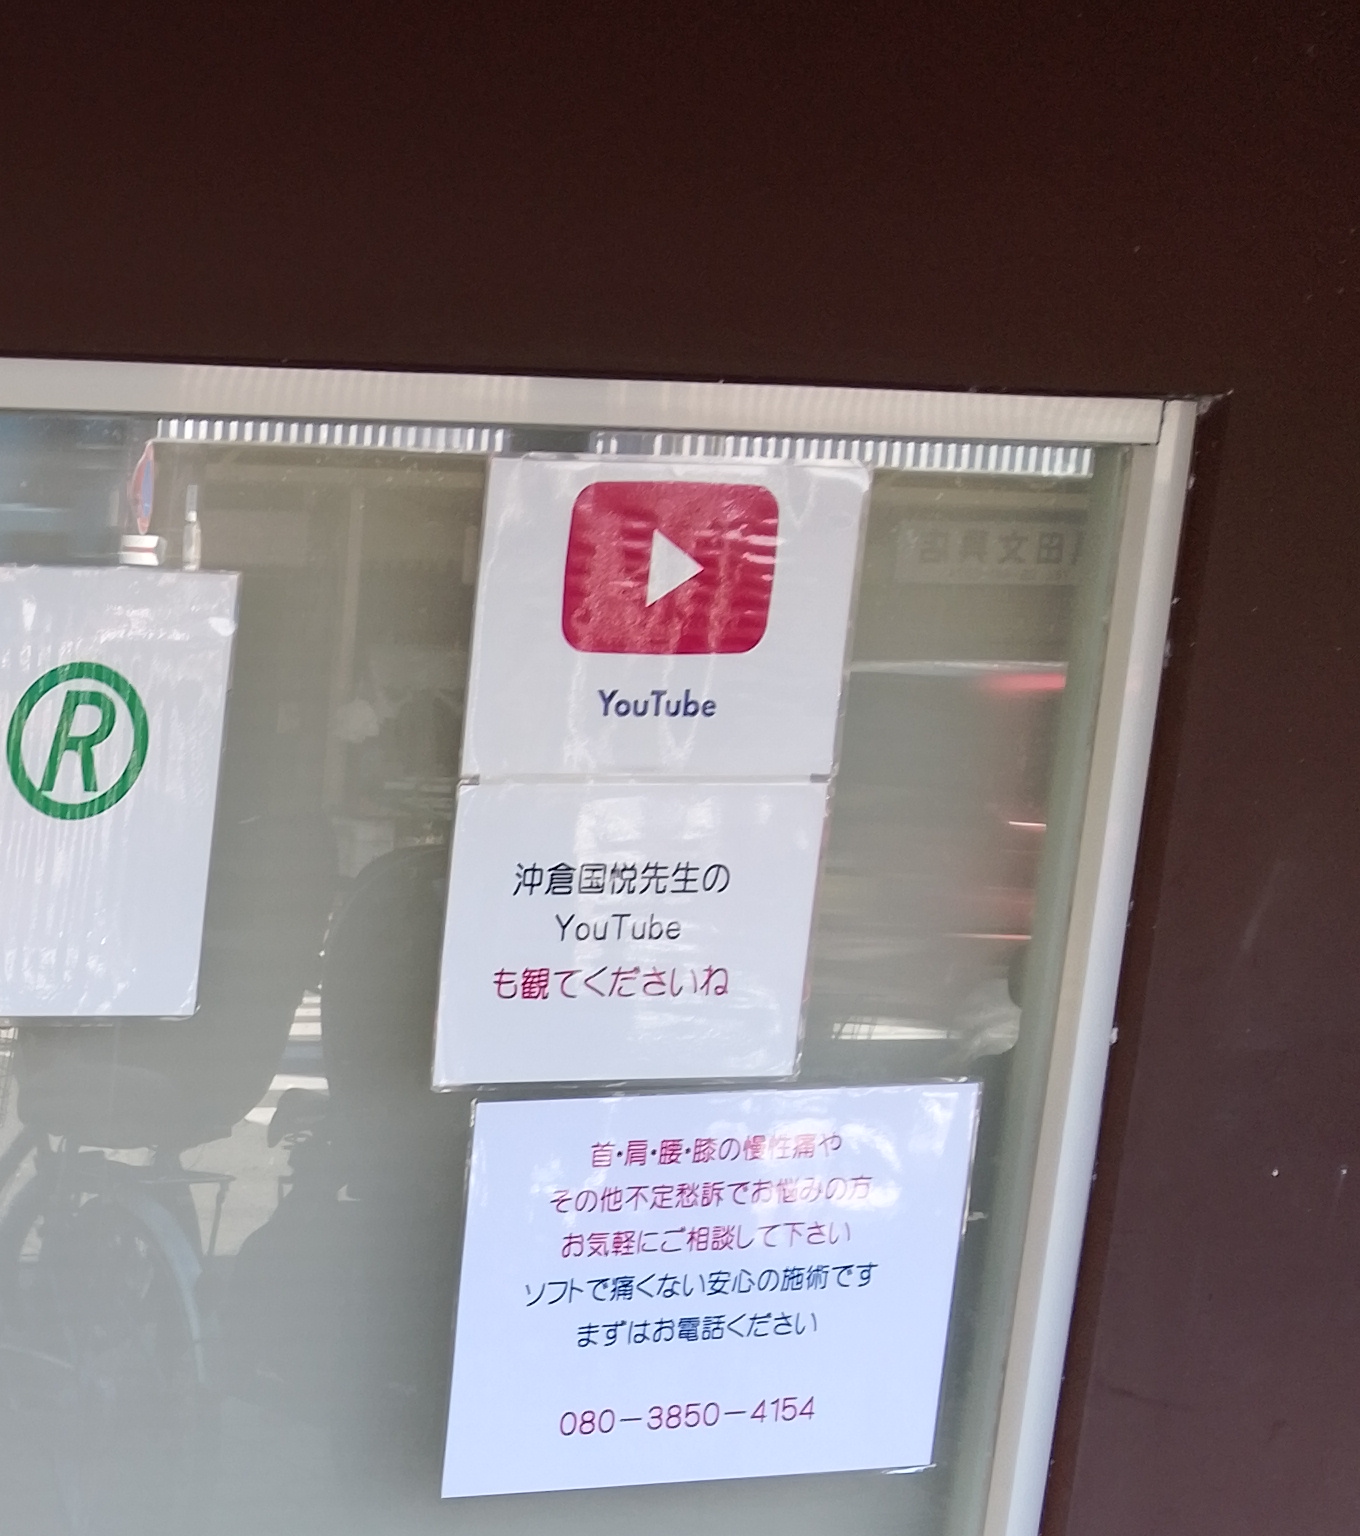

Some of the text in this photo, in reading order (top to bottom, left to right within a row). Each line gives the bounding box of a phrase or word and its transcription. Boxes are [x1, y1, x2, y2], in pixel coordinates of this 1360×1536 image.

[597, 689, 717, 719] YouTube
[512, 861, 730, 897] 沖倉国悦先生の
[554, 914, 682, 942] YouTube
[492, 964, 729, 1002] も観てくださいね
[550, 1175, 874, 1215] その他不定愁訴でお悩みの方
[561, 1219, 851, 1259] お気軽にご相談して下さい
[524, 1261, 880, 1308] ソフトで痛くない安心の施術です
[576, 1310, 819, 1348] まずはお電話ください
